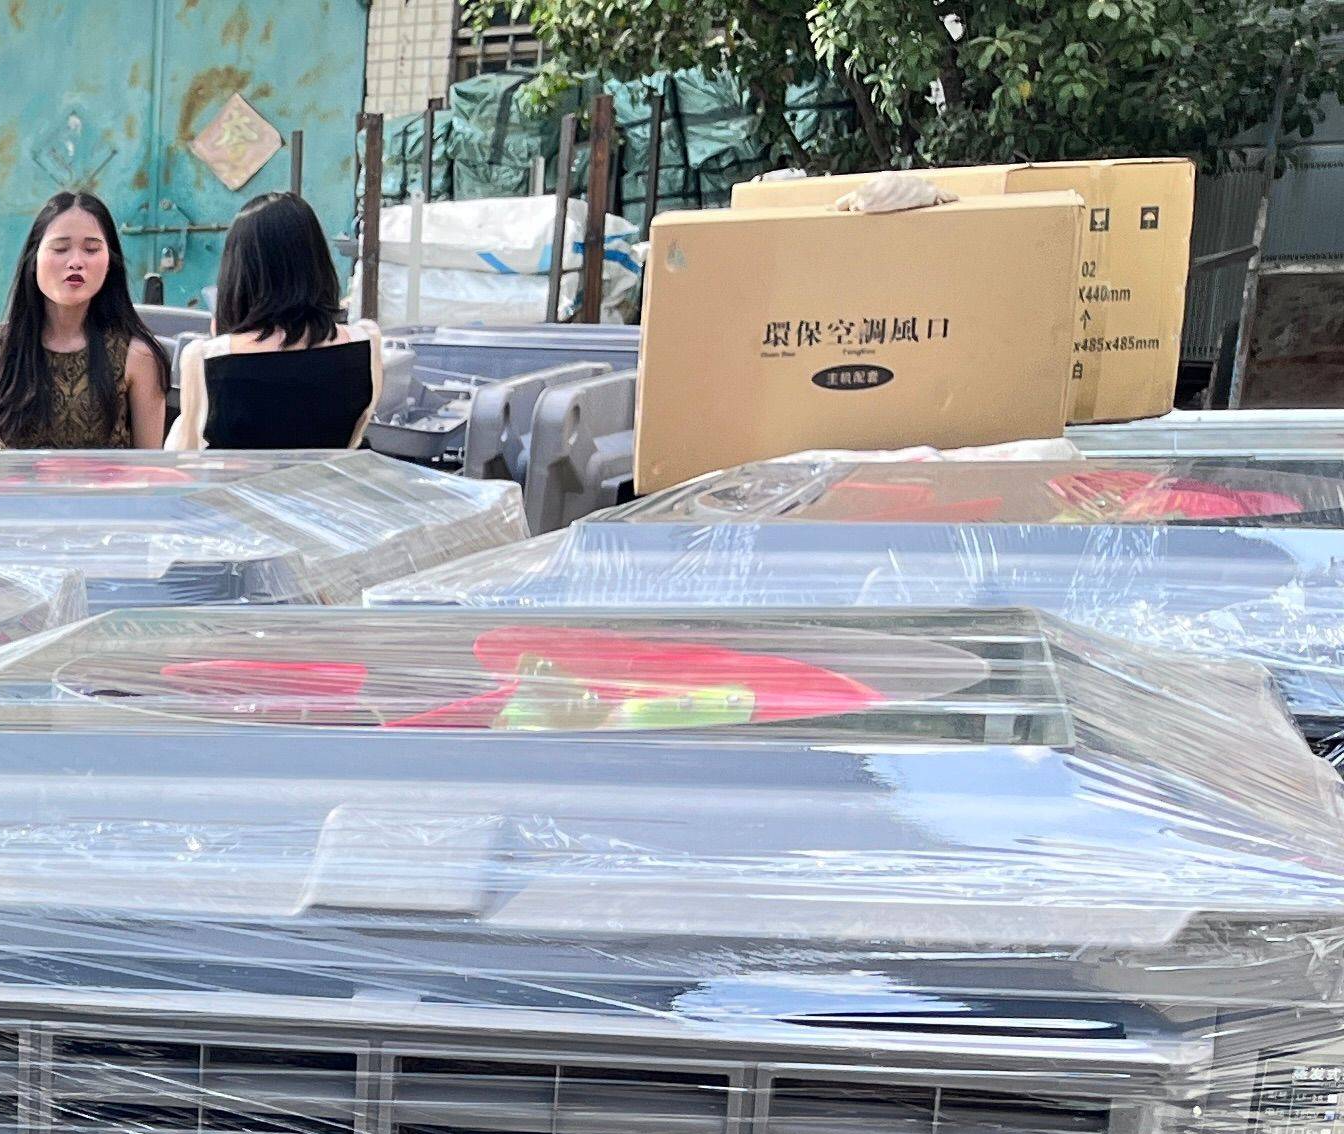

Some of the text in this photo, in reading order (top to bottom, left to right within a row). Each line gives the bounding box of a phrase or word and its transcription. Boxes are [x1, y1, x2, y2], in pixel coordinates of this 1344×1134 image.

[761, 316, 950, 348] 環保空調風口
